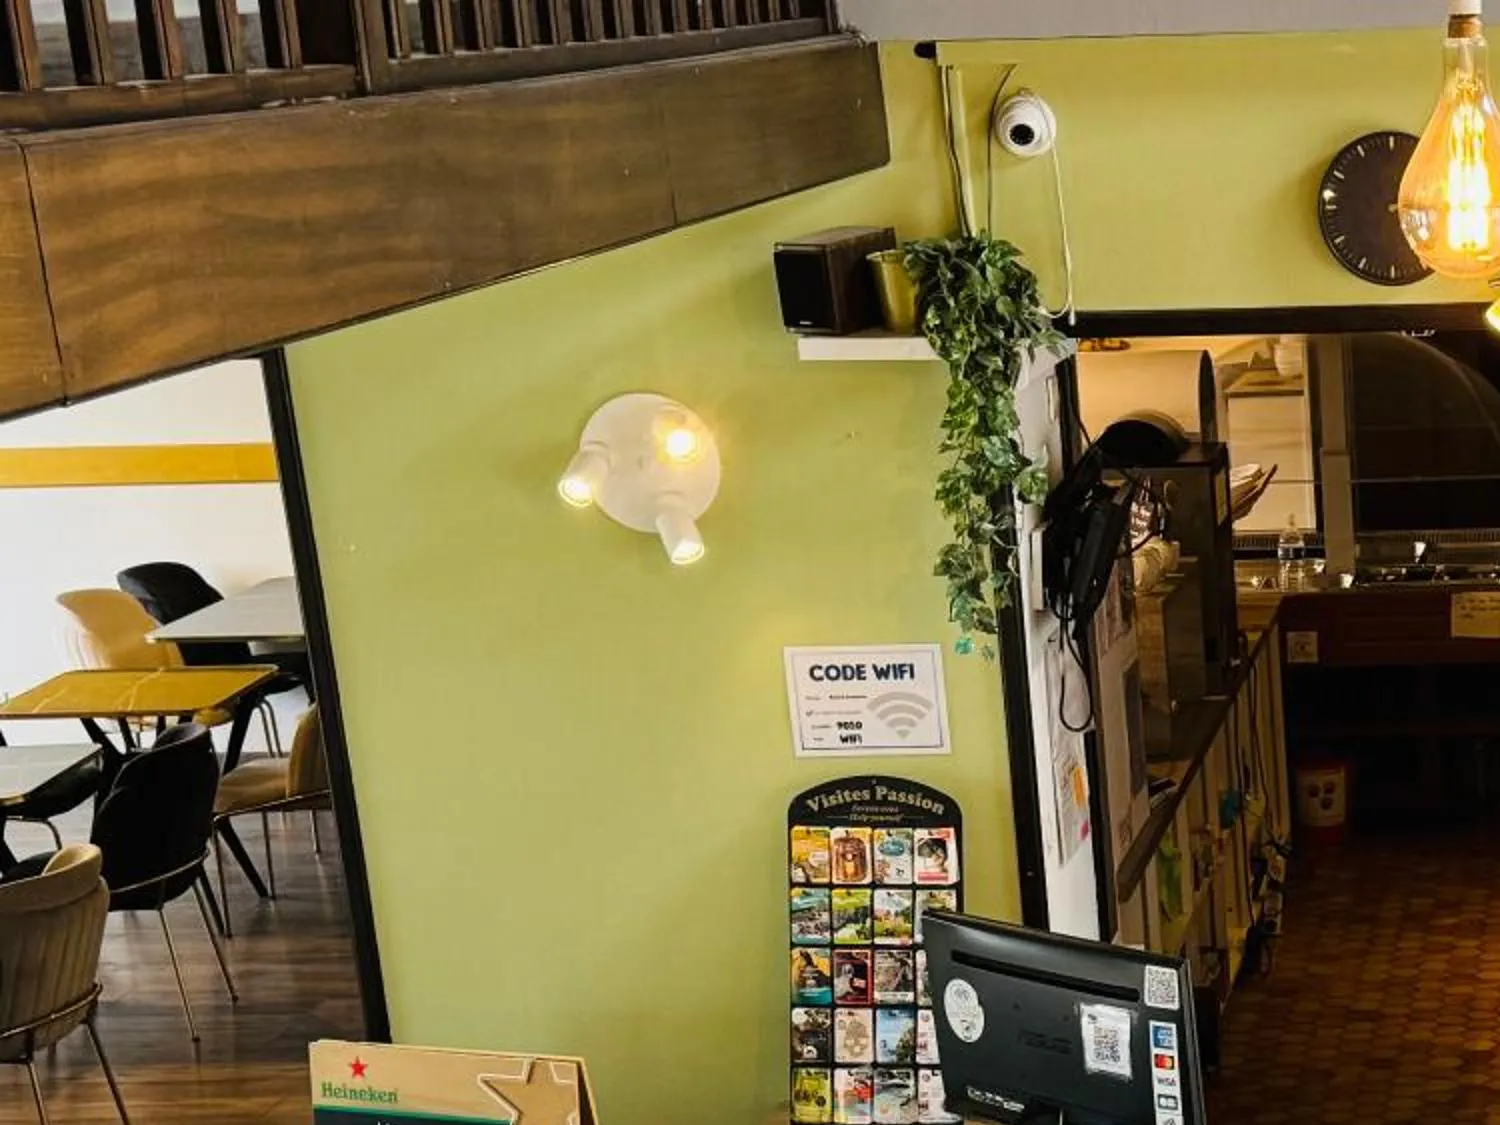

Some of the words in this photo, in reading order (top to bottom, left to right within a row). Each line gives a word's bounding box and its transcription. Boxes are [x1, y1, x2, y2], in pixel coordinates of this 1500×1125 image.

[809, 664, 866, 681] CODE
[872, 663, 915, 681] WIFI
[806, 786, 870, 812] Visites
[875, 785, 945, 815] Passion
[321, 1082, 398, 1103] Heineken
